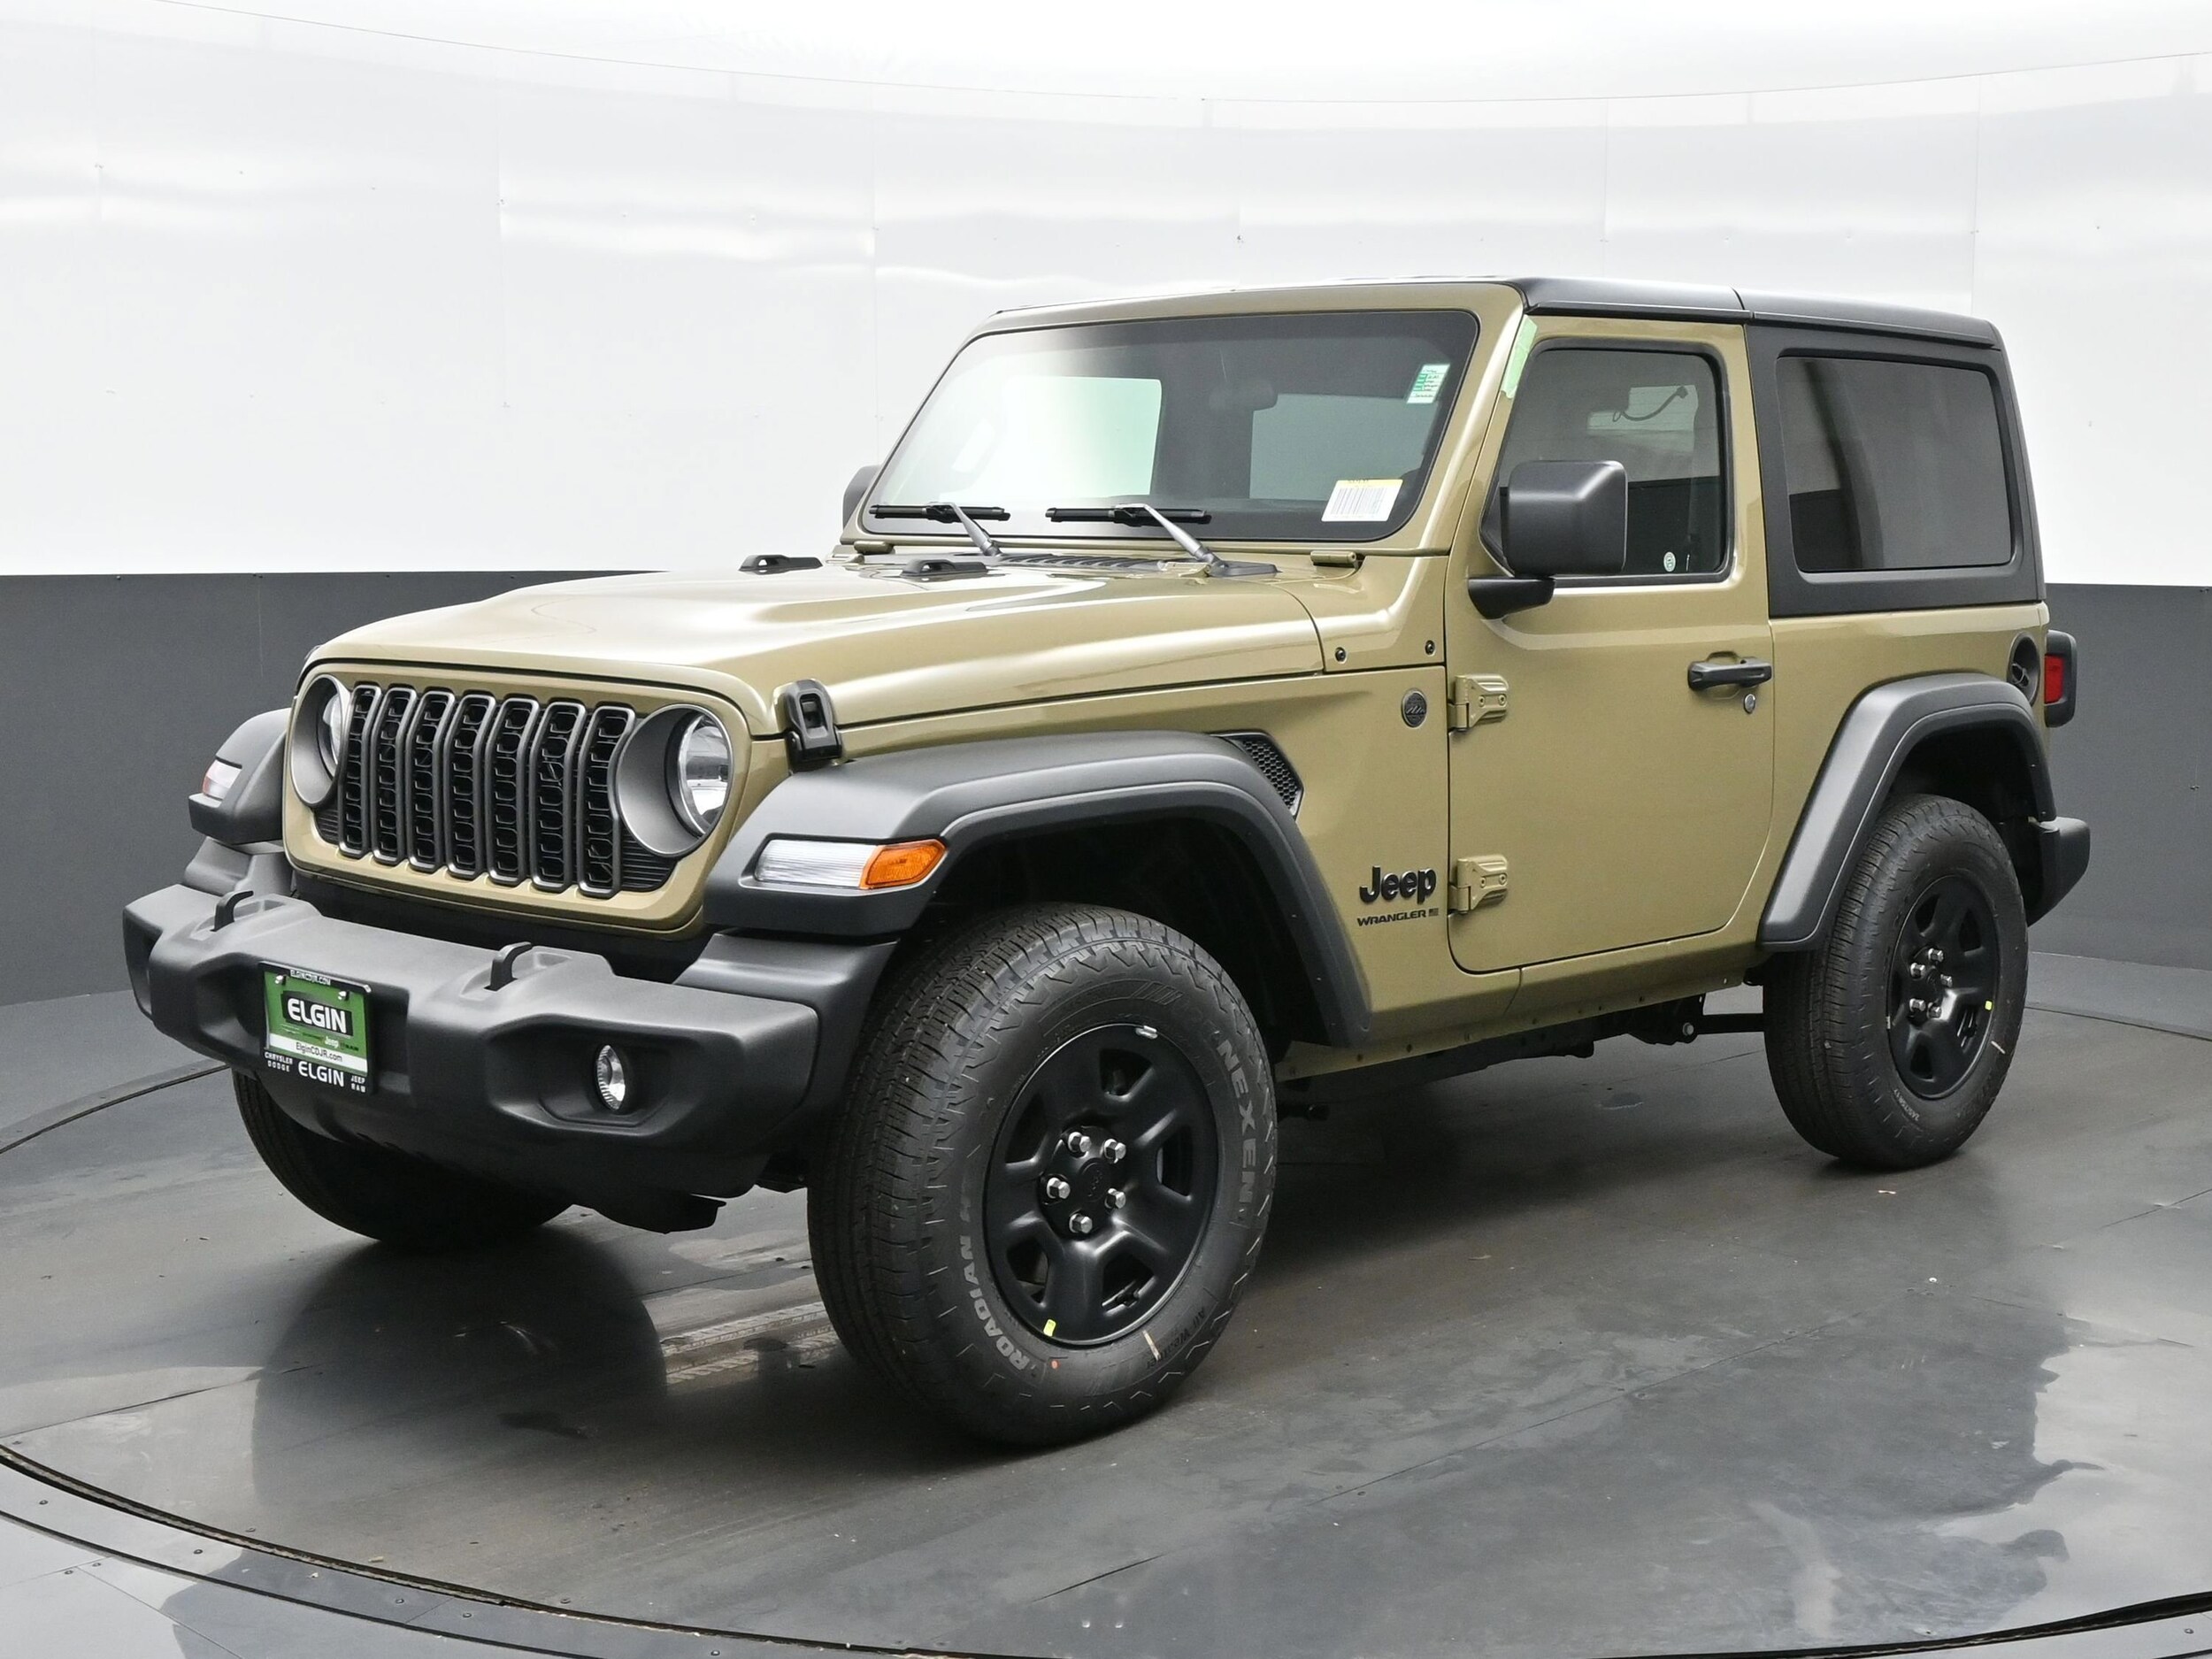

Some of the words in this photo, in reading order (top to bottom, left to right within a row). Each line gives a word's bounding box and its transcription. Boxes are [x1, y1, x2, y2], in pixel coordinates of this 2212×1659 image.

[1359, 864, 1437, 905] Jeep
[1356, 910, 1426, 927] WRANGLER
[287, 997, 347, 1034] ELGIN
[264, 1051, 294, 1065] CHRYSLER
[267, 1060, 291, 1072] DODGE
[296, 1041, 343, 1064] ElginCDJR.com
[297, 1060, 345, 1087] ELGIN
[1217, 1039, 1257, 1204] NEXEN
[959, 1235, 1031, 1371] ROADIAN
